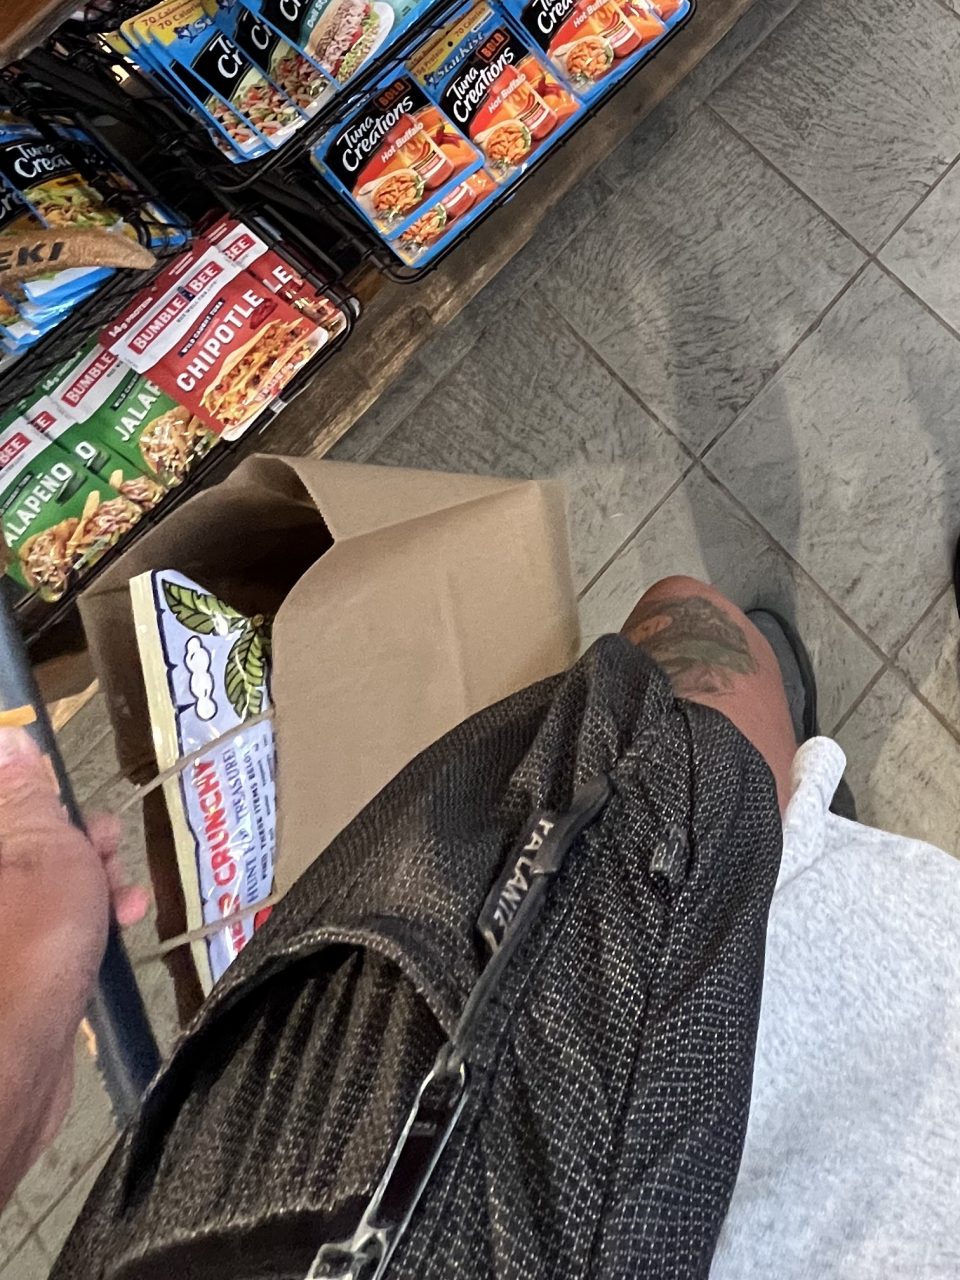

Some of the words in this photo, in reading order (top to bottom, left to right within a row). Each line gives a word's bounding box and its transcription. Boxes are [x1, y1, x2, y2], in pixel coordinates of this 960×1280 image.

[157, 19, 173, 31] 70
[307, 9, 321, 28] Deli
[573, 12, 588, 28] Hot
[480, 31, 506, 59] BOLD
[379, 80, 406, 107] BOLD
[446, 66, 480, 100] Tuna
[452, 46, 515, 124] Creations
[487, 98, 501, 114] Hot
[500, 73, 527, 101] Buffalo
[336, 115, 375, 150] Tuna
[342, 95, 414, 173] Creations
[380, 145, 397, 164] Hot
[395, 121, 425, 149] Buffalo
[0, 241, 65, 271] EKI
[108, 322, 128, 338] 14g
[126, 297, 154, 325] PROTEIN
[132, 296, 187, 351] BUMBLE
[188, 264, 219, 293] BEE
[180, 339, 195, 355] WILD
[192, 315, 213, 342] CAUGHT
[210, 300, 224, 318] TUNA
[176, 289, 265, 393] CHIPOTLE
[65, 351, 116, 403] BUMBLE
[3, 462, 73, 548] ALAPEÑO
[251, 781, 263, 816] ITEMS
[192, 757, 238, 887] CRUNCHY
[243, 856, 259, 904] HUNT
